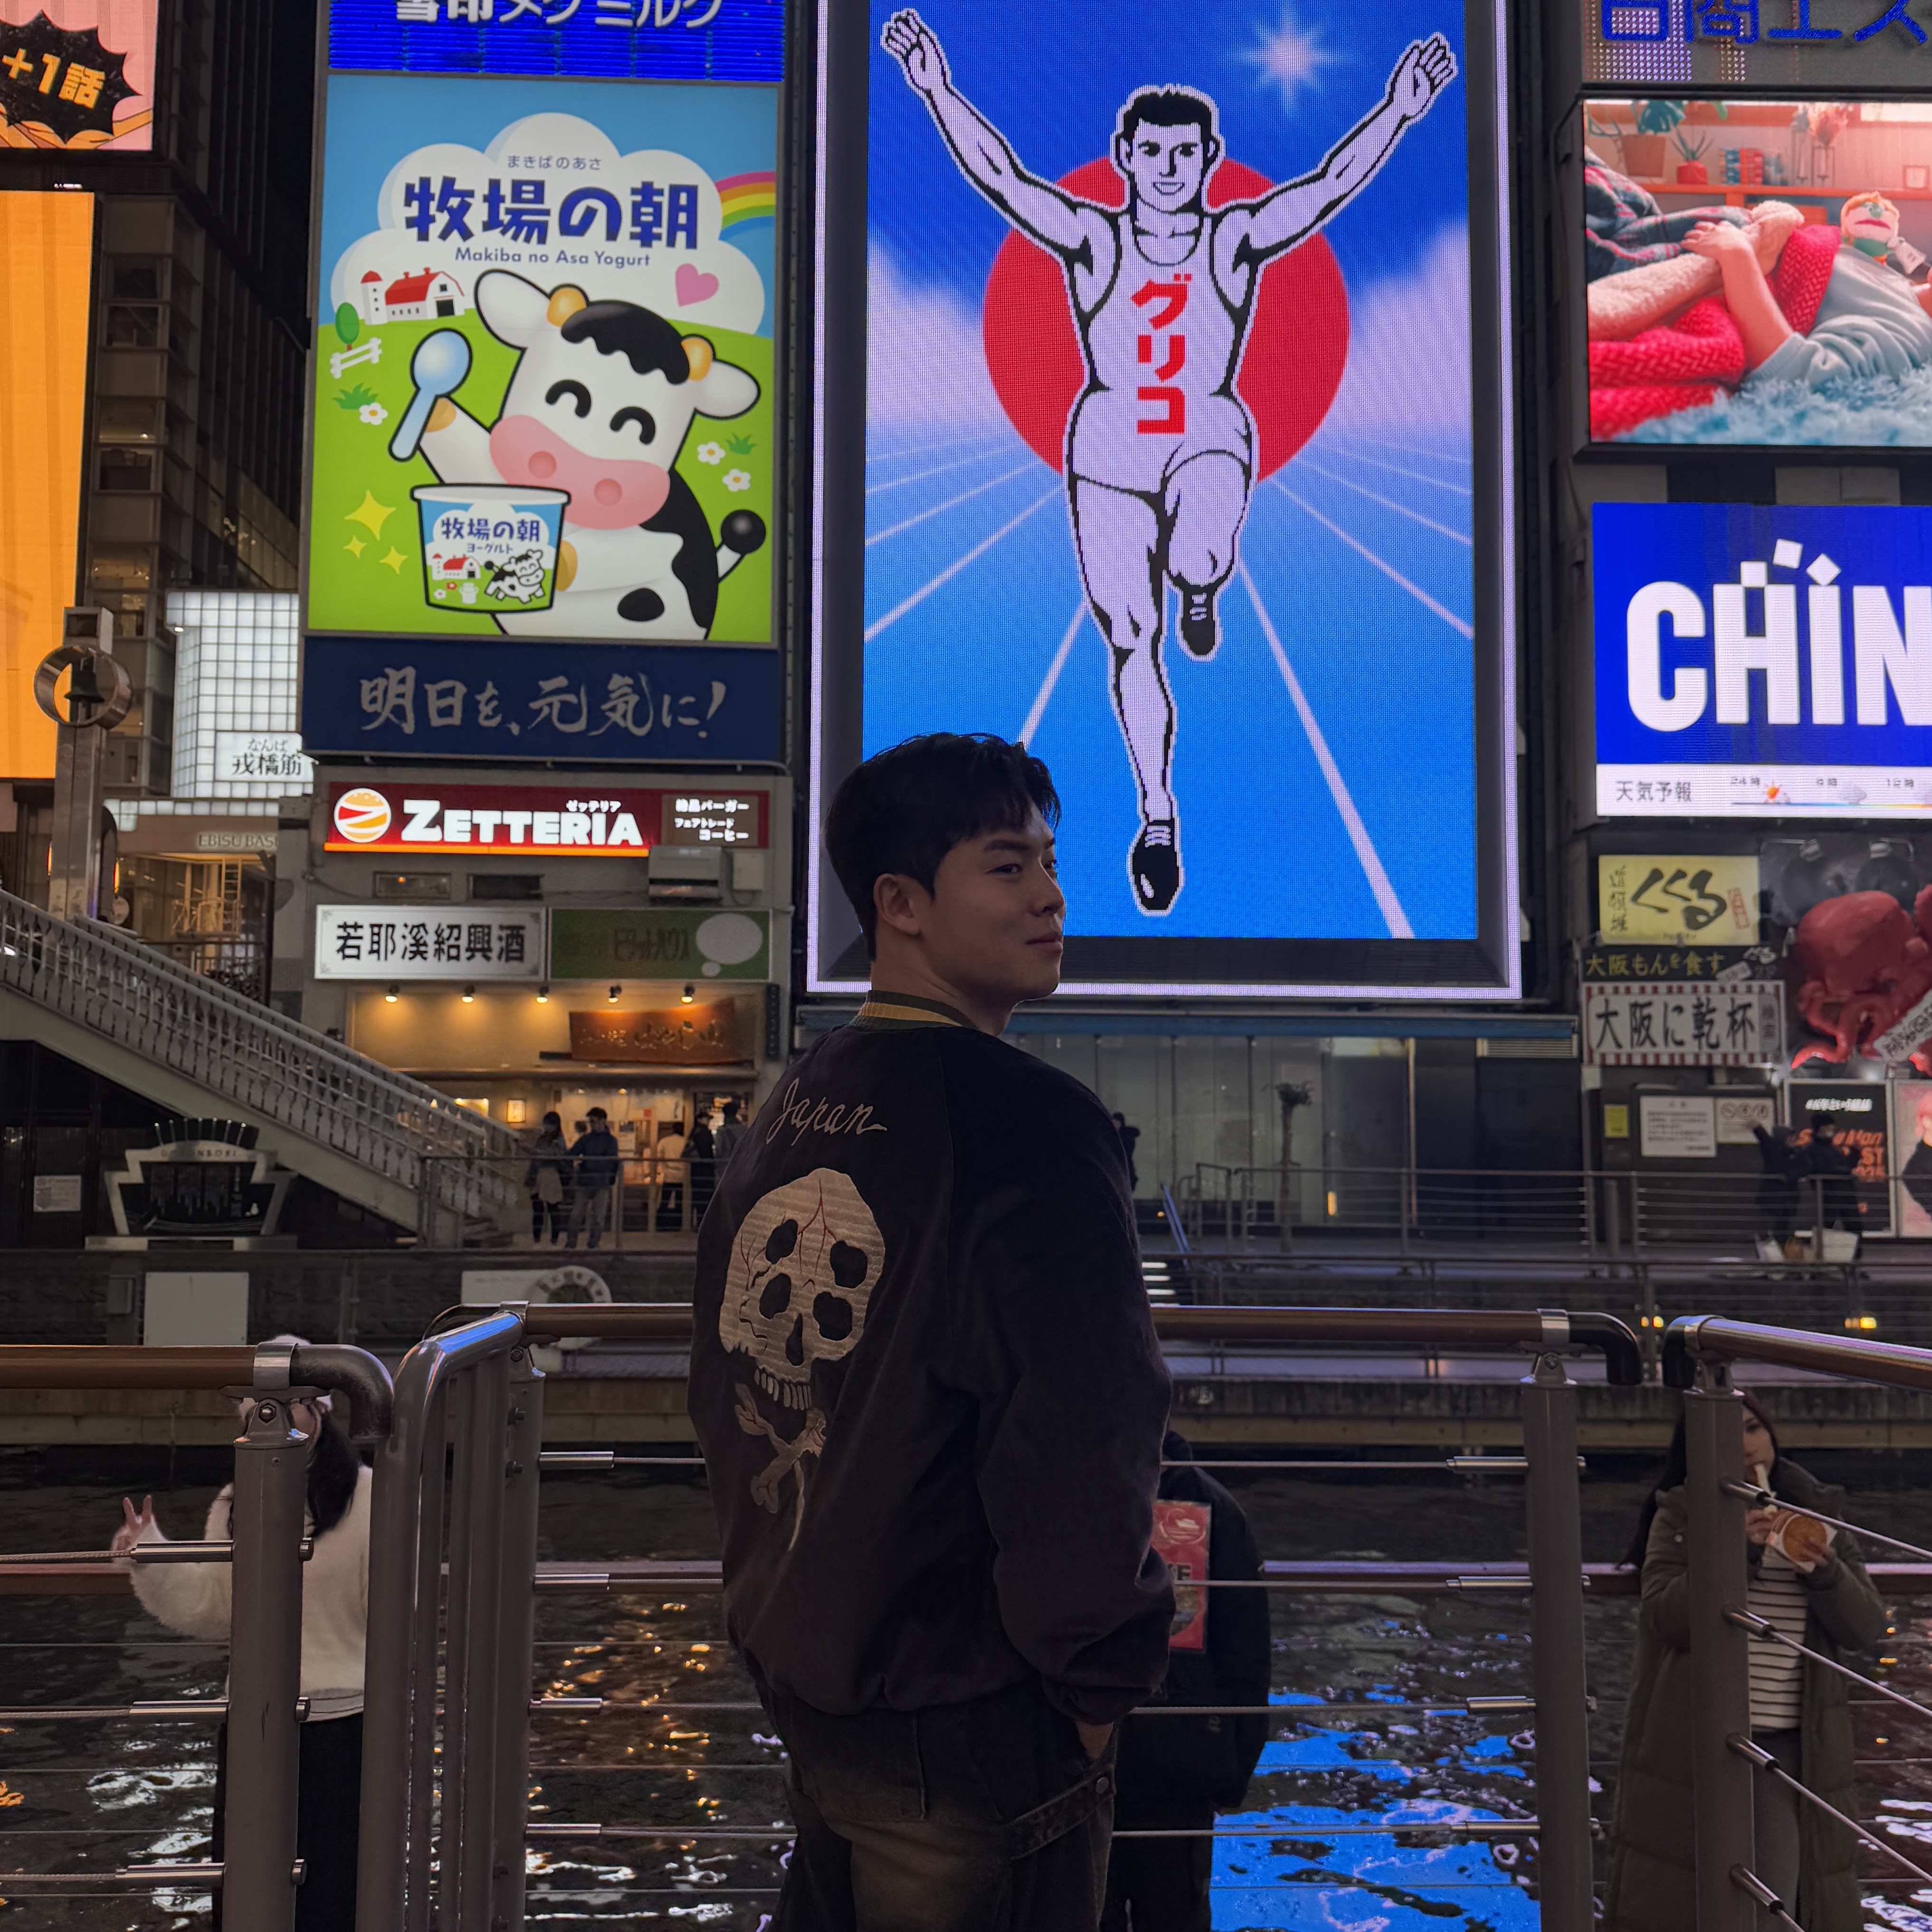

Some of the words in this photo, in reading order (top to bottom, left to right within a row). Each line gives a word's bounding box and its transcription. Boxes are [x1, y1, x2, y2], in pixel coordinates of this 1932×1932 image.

[1, 48, 106, 109] +1話
[507, 155, 602, 170] まきばのあさ
[404, 176, 698, 249] 牧場の朝
[455, 247, 522, 262] Makiba
[529, 252, 548, 263] no
[556, 250, 588, 264] Asa
[594, 251, 650, 269] Yogurt
[1131, 274, 1191, 434] グリコ
[441, 518, 540, 542] 牧場の朝
[467, 543, 513, 554] ヨーグルト
[248, 739, 288, 751] なんば
[231, 752, 301, 776] 戎橋筋
[1617, 780, 1692, 803] 天気予報
[566, 800, 621, 813] ゼッテリア
[401, 799, 644, 846] ZETTERIA
[675, 817, 734, 829] フェアトレード
[199, 834, 241, 847] EBISU
[246, 834, 277, 848] BAS
[699, 829, 749, 842] コーヒー
[1631, 868, 1727, 930] くくる
[1596, 997, 1755, 1051] 大阪に乾杯
[766, 1077, 887, 1146] Japan
